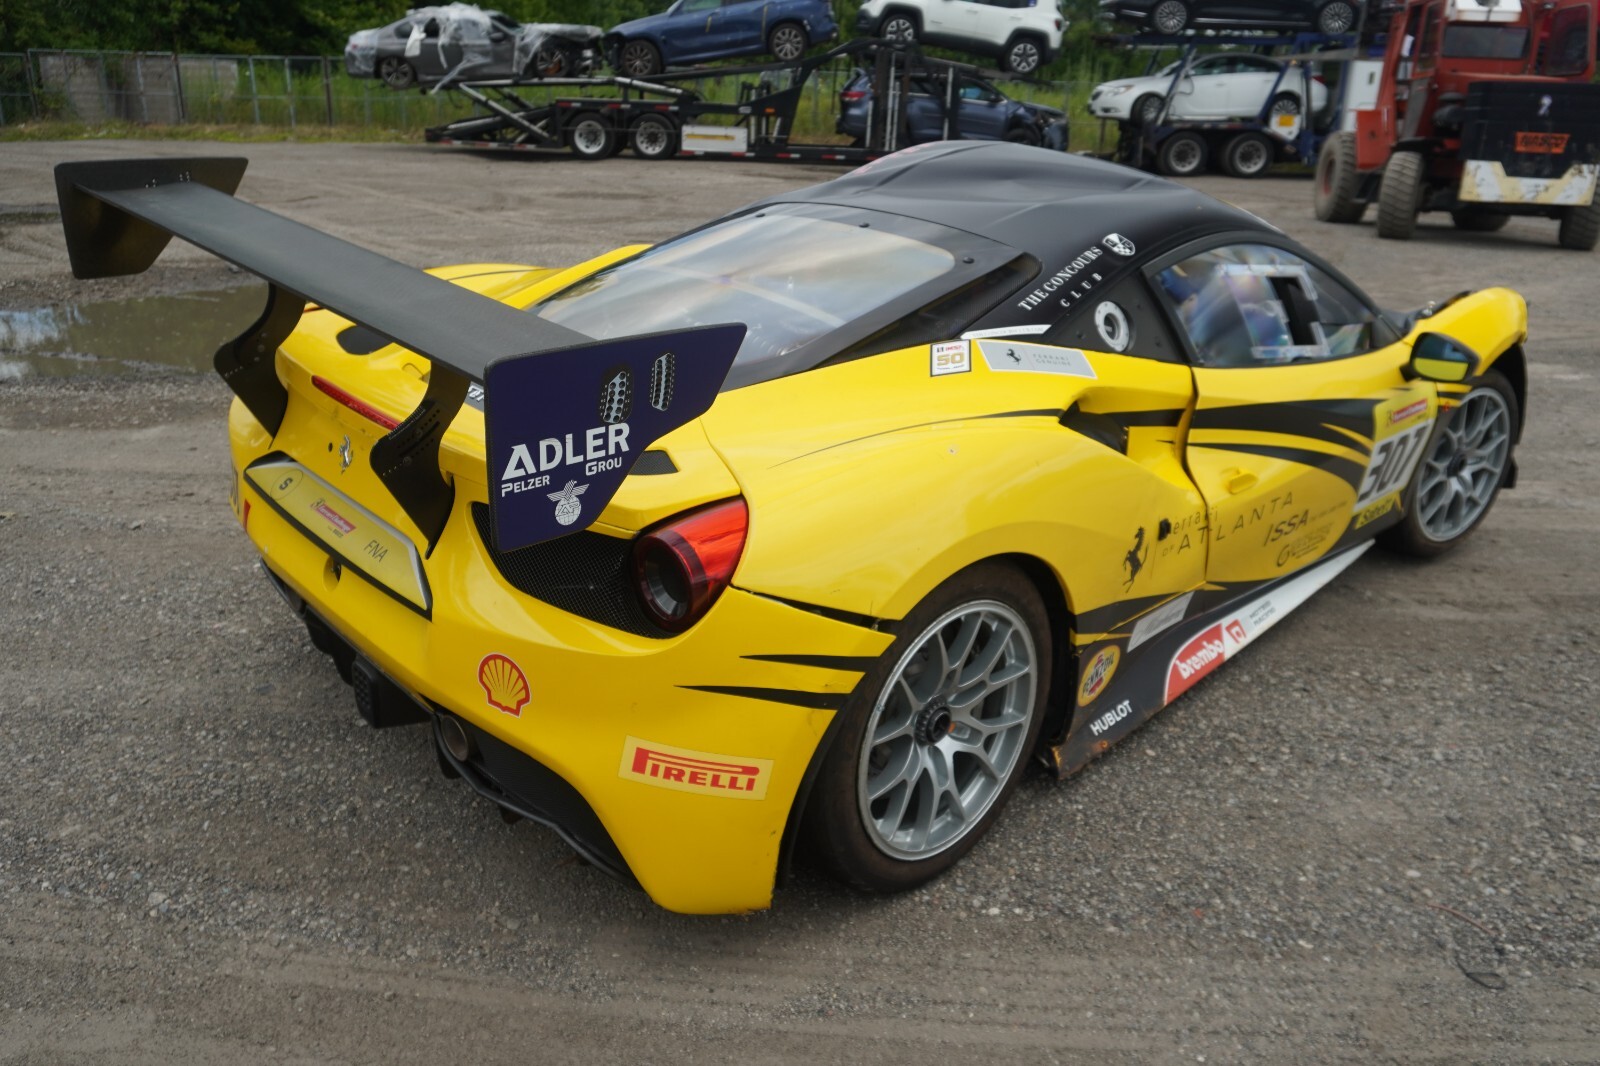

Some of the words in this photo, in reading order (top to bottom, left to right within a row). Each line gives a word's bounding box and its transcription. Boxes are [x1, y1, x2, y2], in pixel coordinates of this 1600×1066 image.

[1018, 289, 1049, 311] THE
[1043, 246, 1103, 292] CONCOURS
[1060, 273, 1102, 307] CLUB
[936, 352, 965, 367] 50
[502, 422, 630, 481] ADLER
[585, 456, 622, 476] GROU
[278, 477, 293, 491] S
[502, 475, 550, 497] PELZER
[1177, 491, 1293, 555] ATLANTA
[1264, 509, 1309, 547] ISSA
[363, 540, 389, 563] FNA
[1081, 654, 1115, 698] PENNZOIL
[1174, 638, 1226, 680] brembo
[1089, 700, 1133, 737] HUBLOT
[631, 747, 760, 791] PIRELLI
